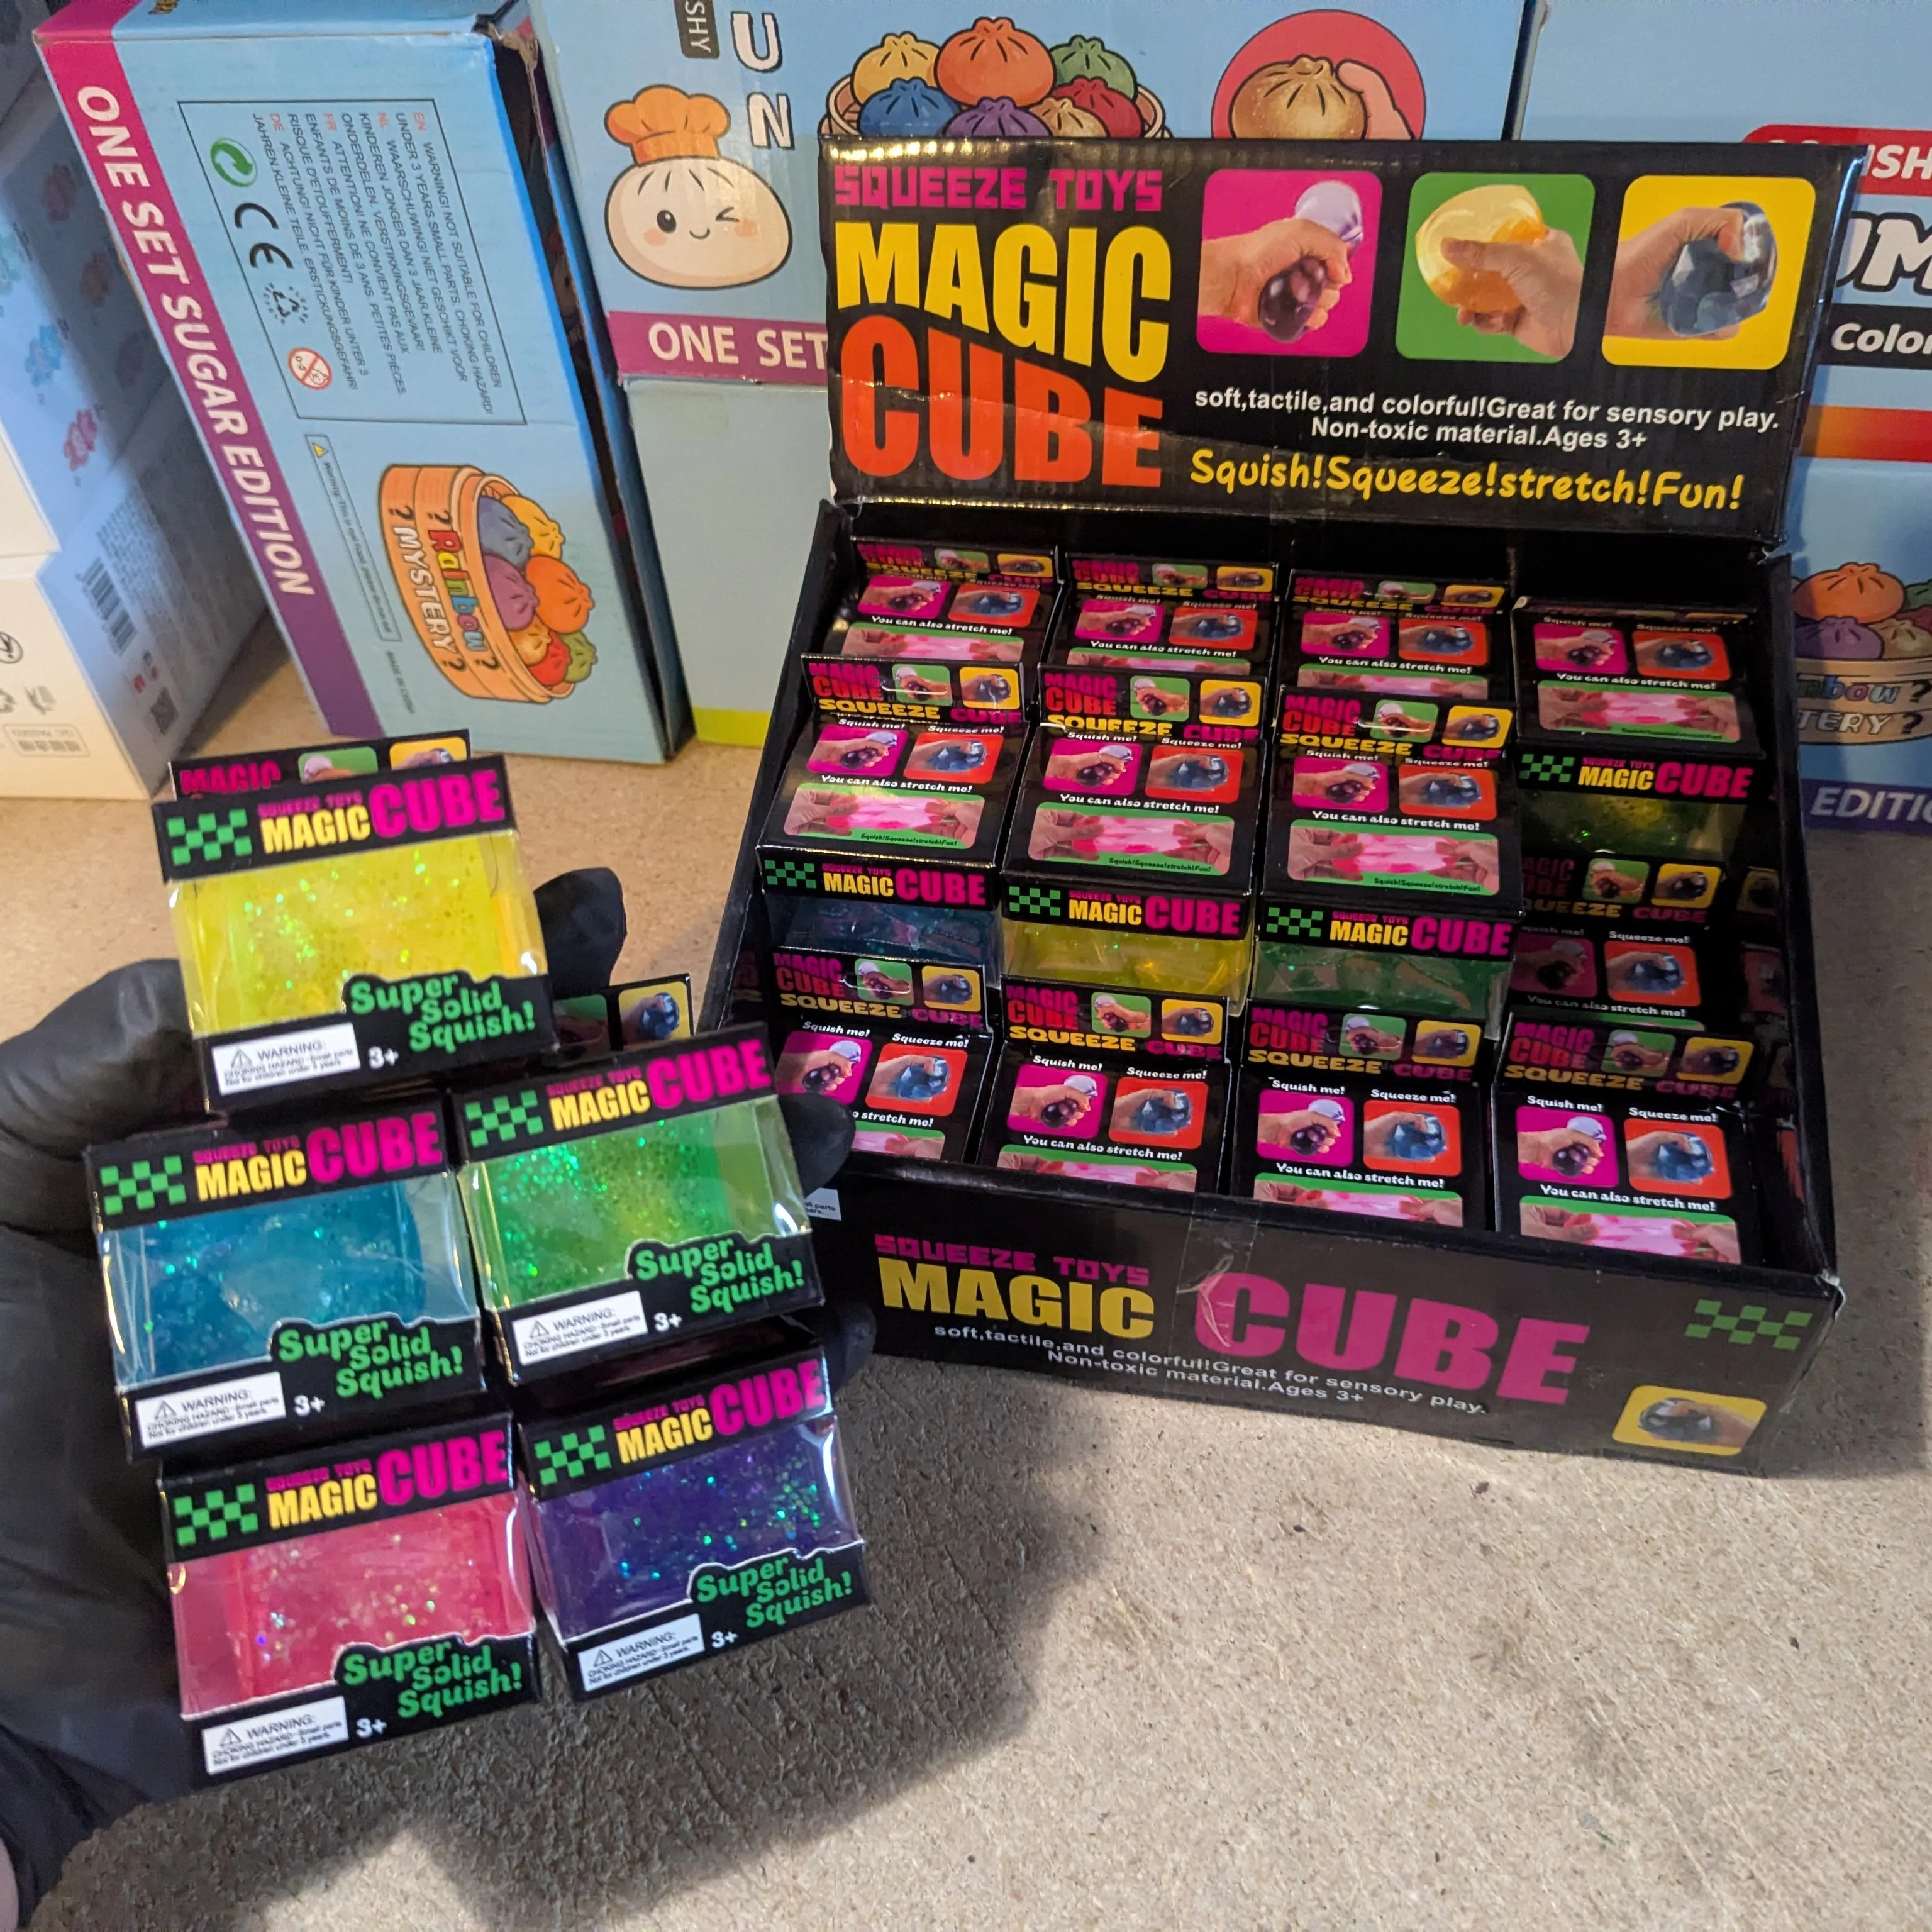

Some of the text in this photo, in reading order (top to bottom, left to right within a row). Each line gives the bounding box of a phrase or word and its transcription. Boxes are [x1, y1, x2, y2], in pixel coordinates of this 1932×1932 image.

[731, 11, 782, 73] U
[287, 114, 313, 164] RISQUE
[304, 113, 334, 173] ENFANTS
[747, 92, 795, 150] N
[326, 178, 341, 194] DE
[331, 141, 365, 216] ATTENTION!
[358, 113, 389, 180] KINDEREN
[381, 185, 406, 236] JONGER
[399, 241, 416, 266] DAN
[834, 165, 1162, 211] SQUEEZE TOYS
[333, 199, 356, 239] MOINS
[358, 221, 372, 236] NE
[279, 142, 311, 208] ACHTUNG!
[304, 213, 325, 250] NICHT
[318, 253, 336, 277] FÜR
[327, 280, 351, 324] KINDER
[344, 328, 365, 365] UNTER
[348, 243, 362, 258] DE
[364, 241, 393, 302] CONVIENT
[385, 140, 428, 252] WAARSCHUWING!
[421, 257, 438, 282] NIET
[430, 287, 457, 345] GESCHIKT
[450, 350, 468, 381] VOOR
[394, 113, 418, 159] UNDER
[440, 265, 462, 306] PARTS.
[455, 311, 479, 362] CHOKING
[471, 367, 494, 414] HAZARD!
[422, 142, 450, 208] WARNING!
[442, 212, 459, 238] NOT
[452, 242, 477, 299] SUITABLE
[469, 303, 485, 326] FOR
[477, 331, 503, 387] CHILDREN
[358, 273, 376, 299] ANS.
[835, 222, 1171, 382] MAGIC
[368, 303, 393, 350] PETITES
[386, 306, 401, 327] PAS
[77, 86, 314, 596] ONE SET SUGAR EDITION
[394, 331, 410, 353] AUX
[648, 323, 828, 370] ONE SET
[840, 315, 1163, 487] CUBE
[1195, 386, 1779, 433] soft,tactile,and colorful!Great for sensory play.
[1312, 416, 1646, 452] Non-toxic material.Ages 3+
[393, 526, 457, 653] MYSTERY
[1556, 672, 1582, 682] You
[1611, 676, 1638, 685] also
[1640, 679, 1688, 689] stretch
[180, 760, 280, 795] MAGIC
[821, 775, 843, 785] You
[872, 779, 898, 787] also
[900, 781, 945, 791] stretch
[948, 785, 972, 793] me!
[1578, 767, 1655, 791] MAGIC
[1655, 761, 1753, 798] CUBE
[368, 769, 504, 838] CUBE
[260, 804, 370, 854] MAGIC
[823, 872, 894, 897] MAGIC
[896, 868, 985, 906] CUBE
[1069, 900, 1142, 926] MAGIC
[1145, 896, 1240, 935] CUBE
[1330, 921, 1408, 947] MAGIC
[1411, 916, 1512, 955] CUBE
[350, 974, 459, 1013] Super
[419, 982, 502, 1023] Solid
[1006, 985, 1078, 1008] MAGIC
[1008, 999, 1078, 1030] CUBE
[409, 1002, 536, 1052] Squish!
[1009, 1026, 1222, 1060] SQUEEZE CUBE
[368, 1046, 399, 1069] 3+
[647, 1038, 772, 1109] CUBE
[1033, 1055, 1102, 1072] Squish me!
[1126, 1067, 1207, 1079] Squeeze me!
[548, 1079, 650, 1131] MAGIC
[306, 1112, 443, 1182] CUBE
[1023, 1134, 1182, 1160] You can also stretch me!
[195, 1150, 306, 1202] MAGIC
[635, 1238, 733, 1281] Super
[701, 1244, 774, 1286] Solid
[874, 1234, 1148, 1285] SQUEEZE TOYS
[691, 1260, 804, 1313] Squish!
[878, 1257, 1155, 1339] MAGIC
[278, 1321, 388, 1362] Super
[653, 1312, 682, 1332] 3+
[1196, 1272, 1591, 1404] CUBE
[349, 1329, 431, 1370] Solid
[934, 1324, 1487, 1414] soft,tactile,and colorful!Great for sensory play.
[335, 1347, 463, 1399] Squish!
[1048, 1350, 1363, 1402] Non-toxic material.Ages 3+
[294, 1394, 325, 1416] 3+
[709, 1359, 826, 1436] CUBE
[616, 1408, 713, 1465] MAGIC
[377, 1430, 509, 1506] CUBE
[267, 1474, 377, 1530] MAGIC
[696, 1557, 789, 1603] Super
[746, 1572, 852, 1629] Squish!
[757, 1558, 825, 1603] Solid
[343, 1640, 452, 1685] Super
[711, 1631, 738, 1648] 3+
[397, 1663, 522, 1719] Squish!
[413, 1646, 492, 1691] Solid
[357, 1718, 387, 1738] 3+
